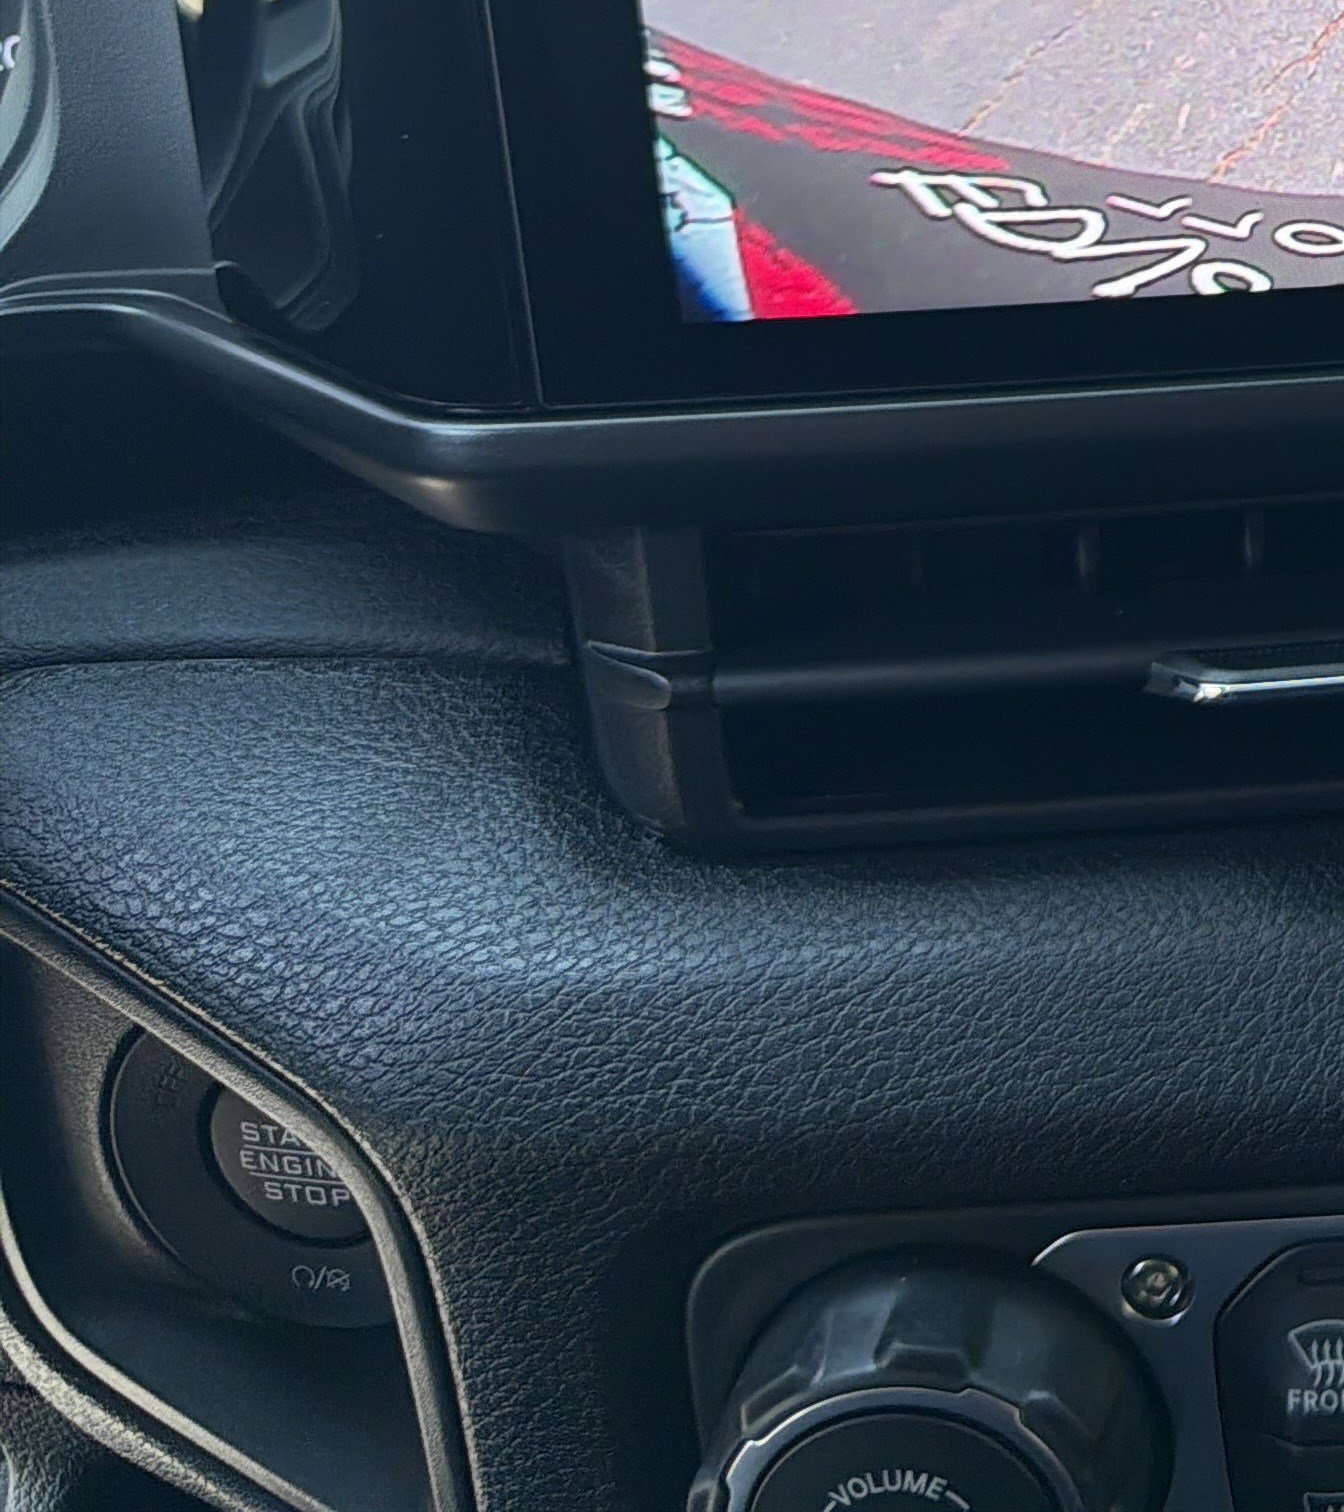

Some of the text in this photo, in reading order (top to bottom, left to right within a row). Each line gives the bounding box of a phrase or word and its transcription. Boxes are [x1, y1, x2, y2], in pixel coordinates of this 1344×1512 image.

[240, 1120, 302, 1146] STA
[239, 1149, 337, 1176] ENGIN
[263, 1179, 351, 1208] STOP
[831, 1468, 949, 1508] VOLUME
